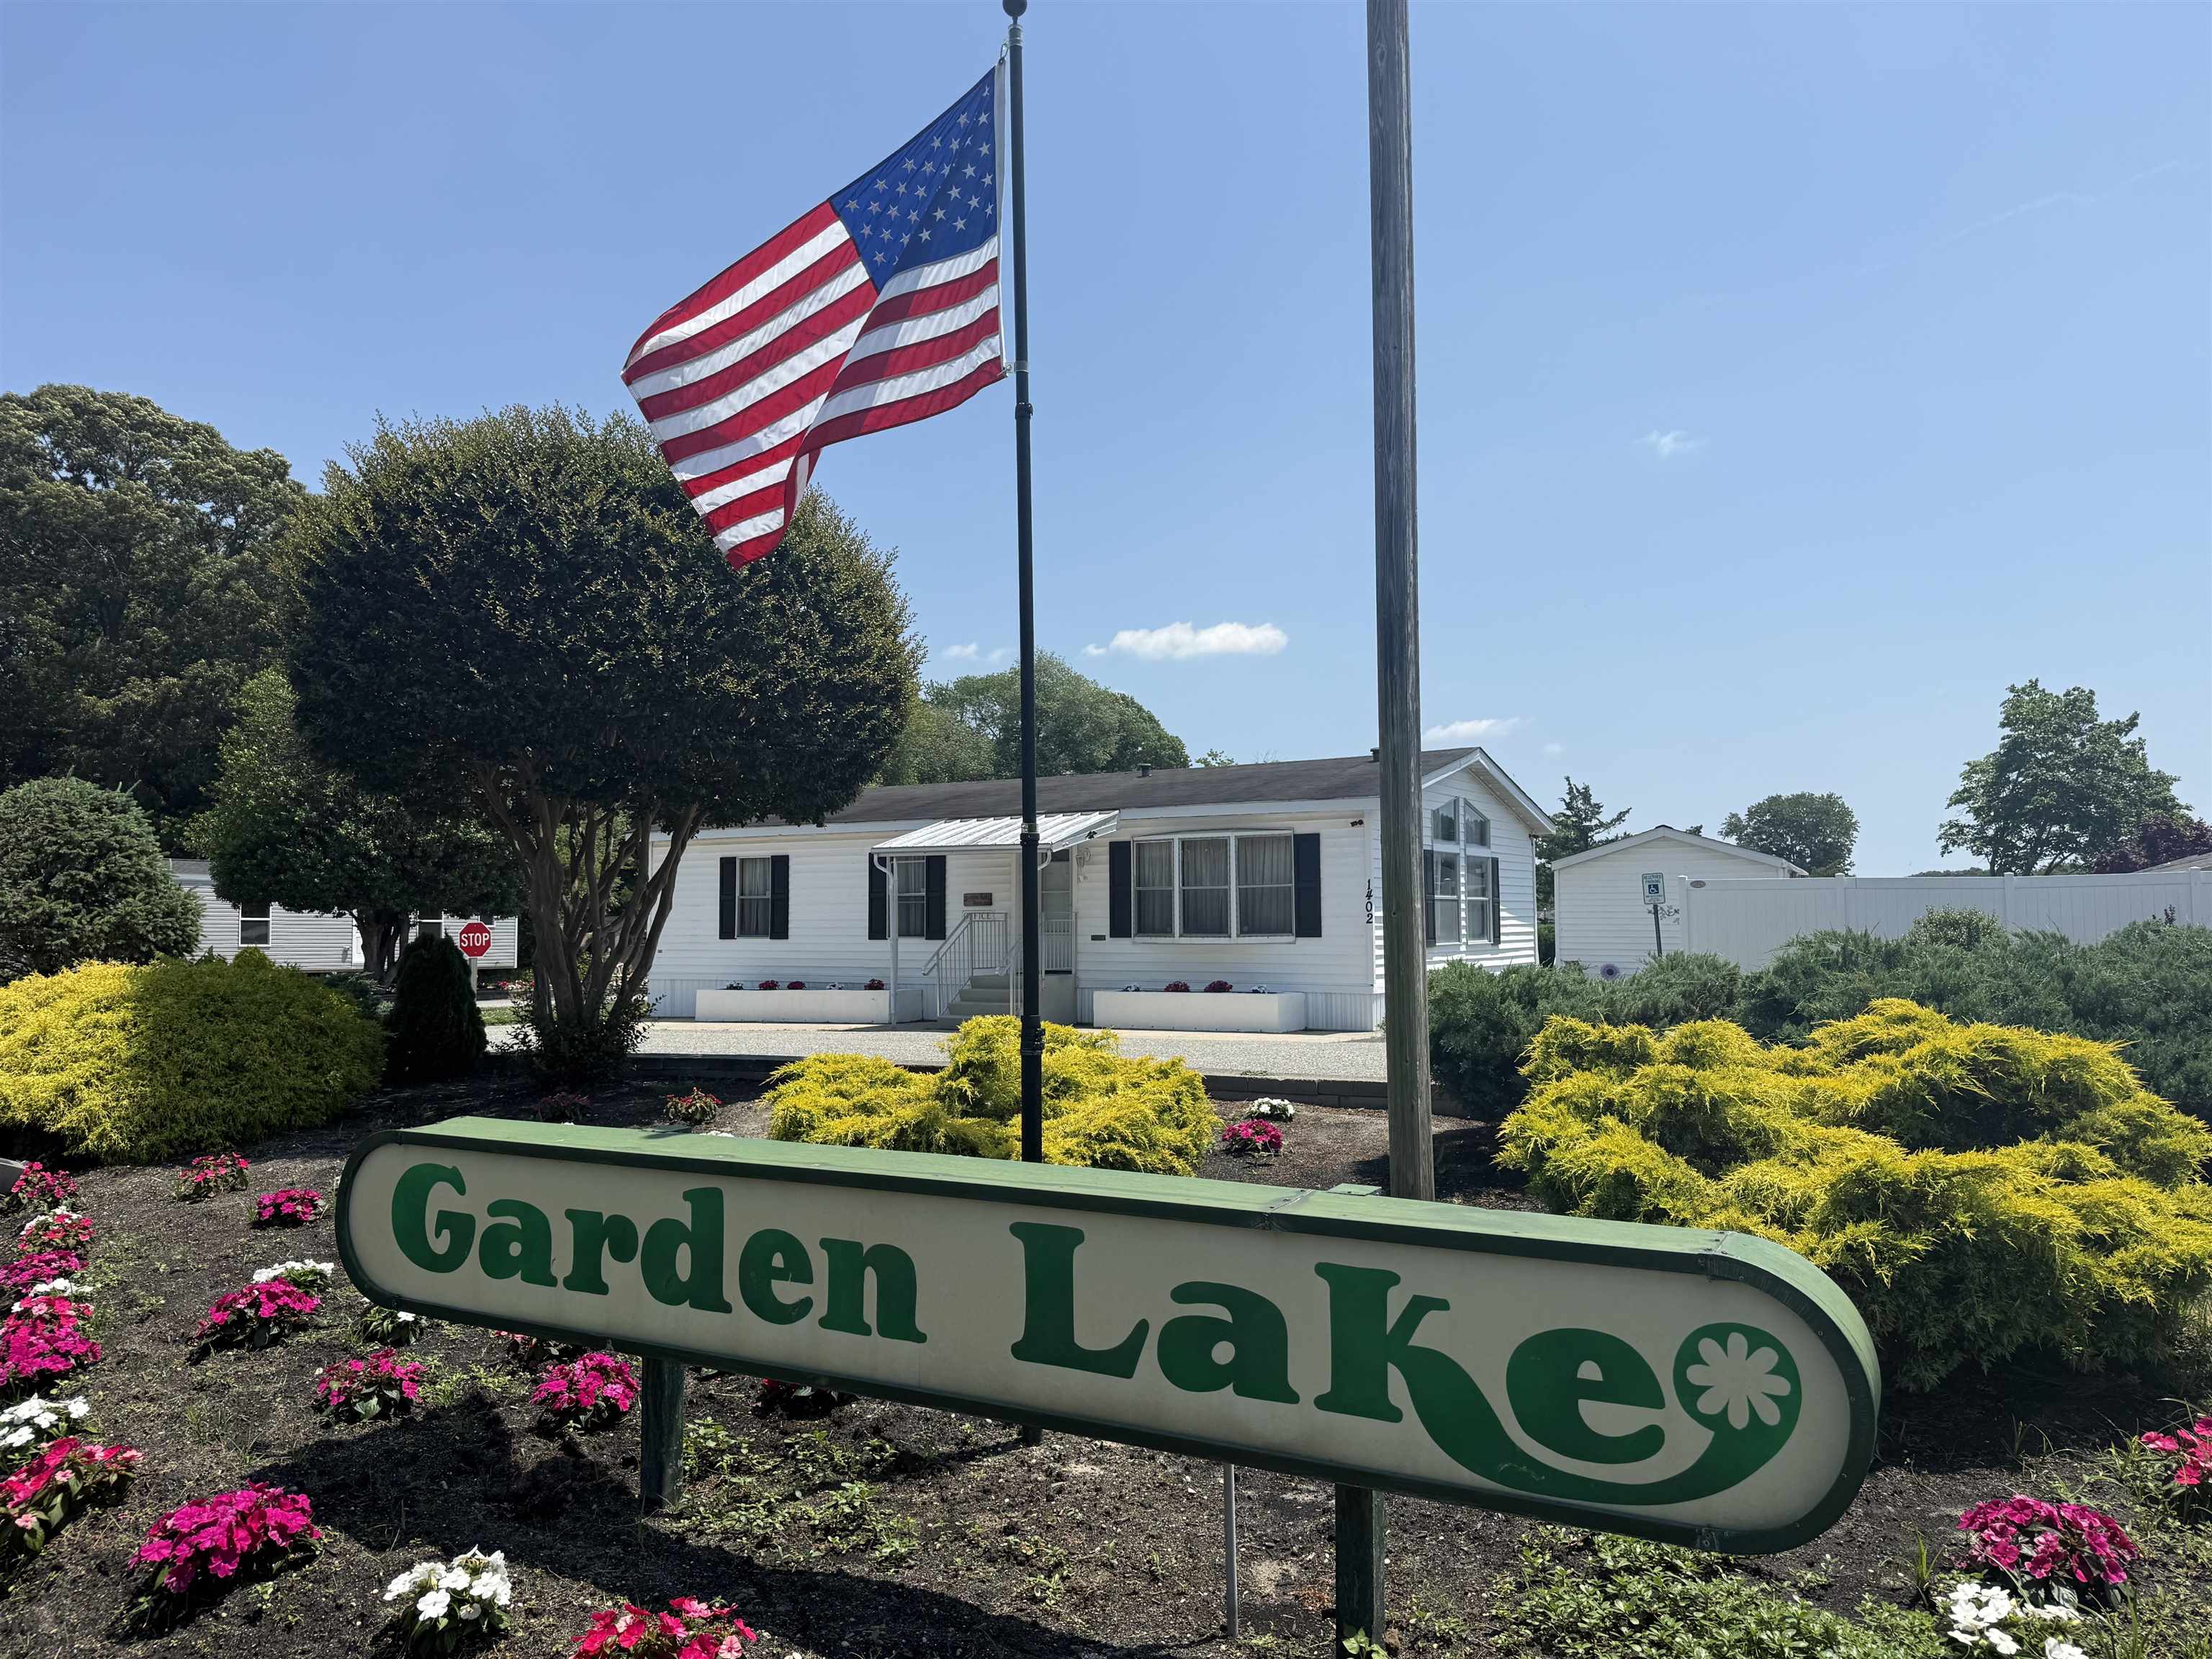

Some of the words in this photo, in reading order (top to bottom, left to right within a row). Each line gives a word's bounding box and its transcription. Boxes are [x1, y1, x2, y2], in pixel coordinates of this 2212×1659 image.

[461, 932, 490, 947] STOP
[390, 1162, 929, 1344] Garden
[1009, 1221, 1803, 1506] Lake
